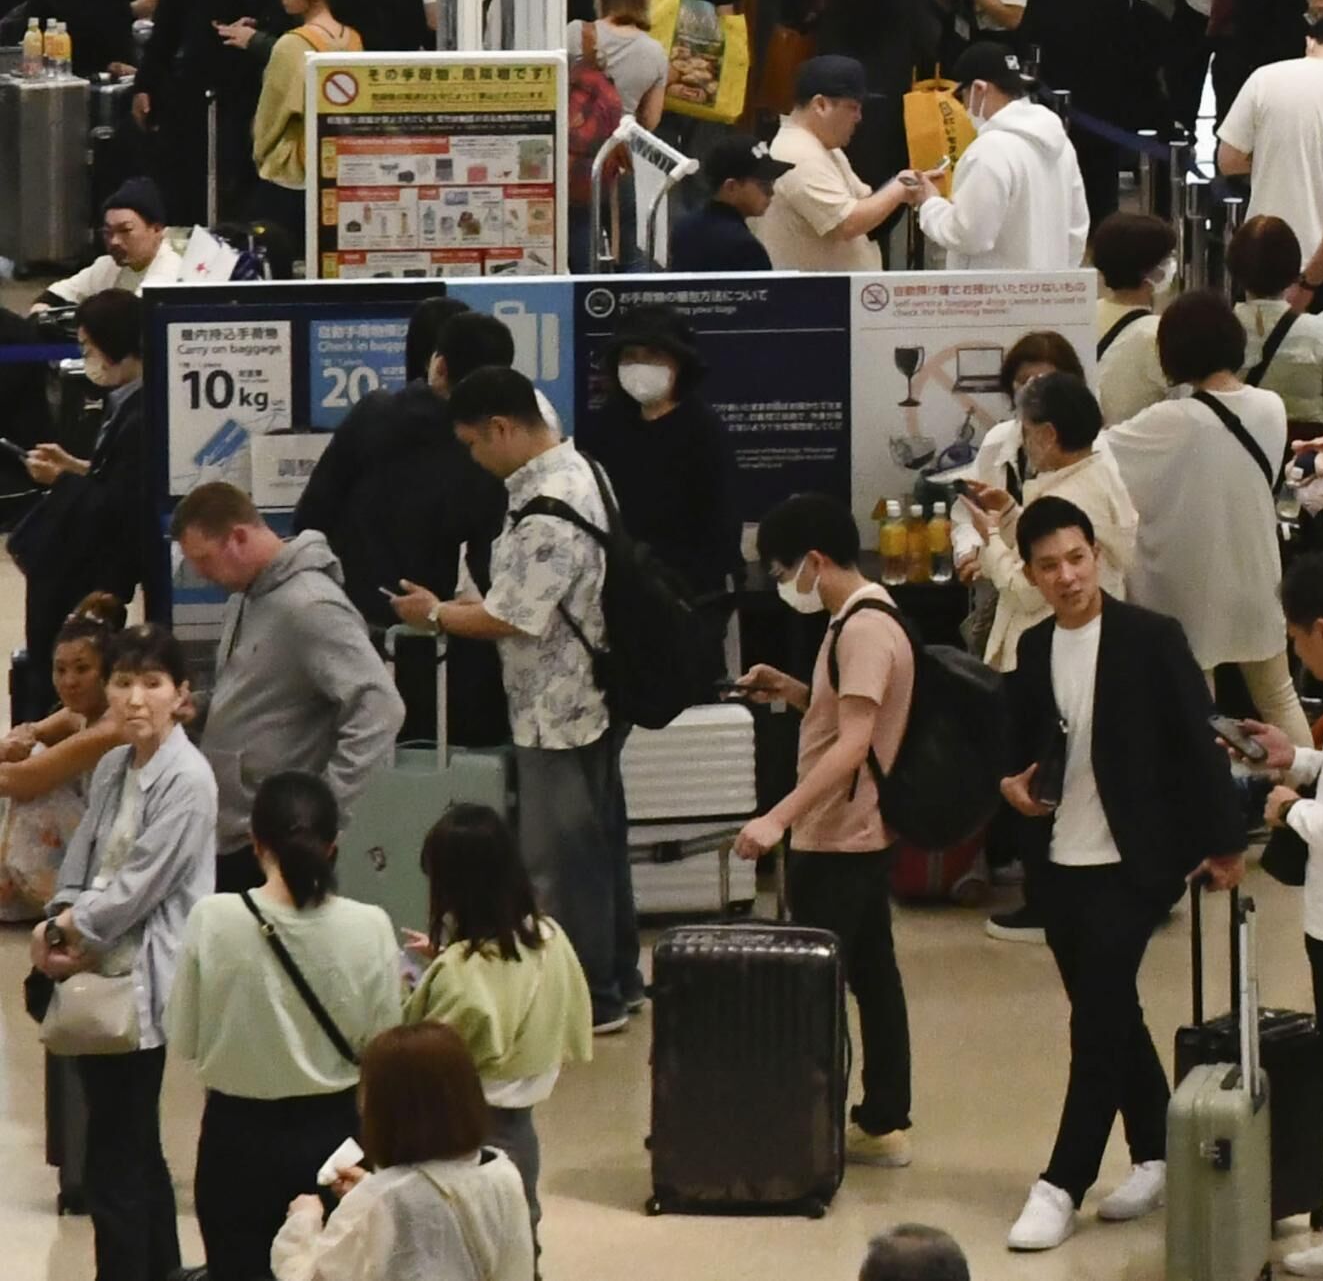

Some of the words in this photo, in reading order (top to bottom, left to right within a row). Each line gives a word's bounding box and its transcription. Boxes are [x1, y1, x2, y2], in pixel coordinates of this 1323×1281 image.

[181, 327, 279, 342] 機内持込手荷物
[177, 344, 210, 355] Carry
[212, 345, 227, 354] on
[230, 344, 282, 355] baggage
[182, 369, 234, 410] 10
[239, 387, 269, 412] kg
[321, 367, 379, 408] 20
